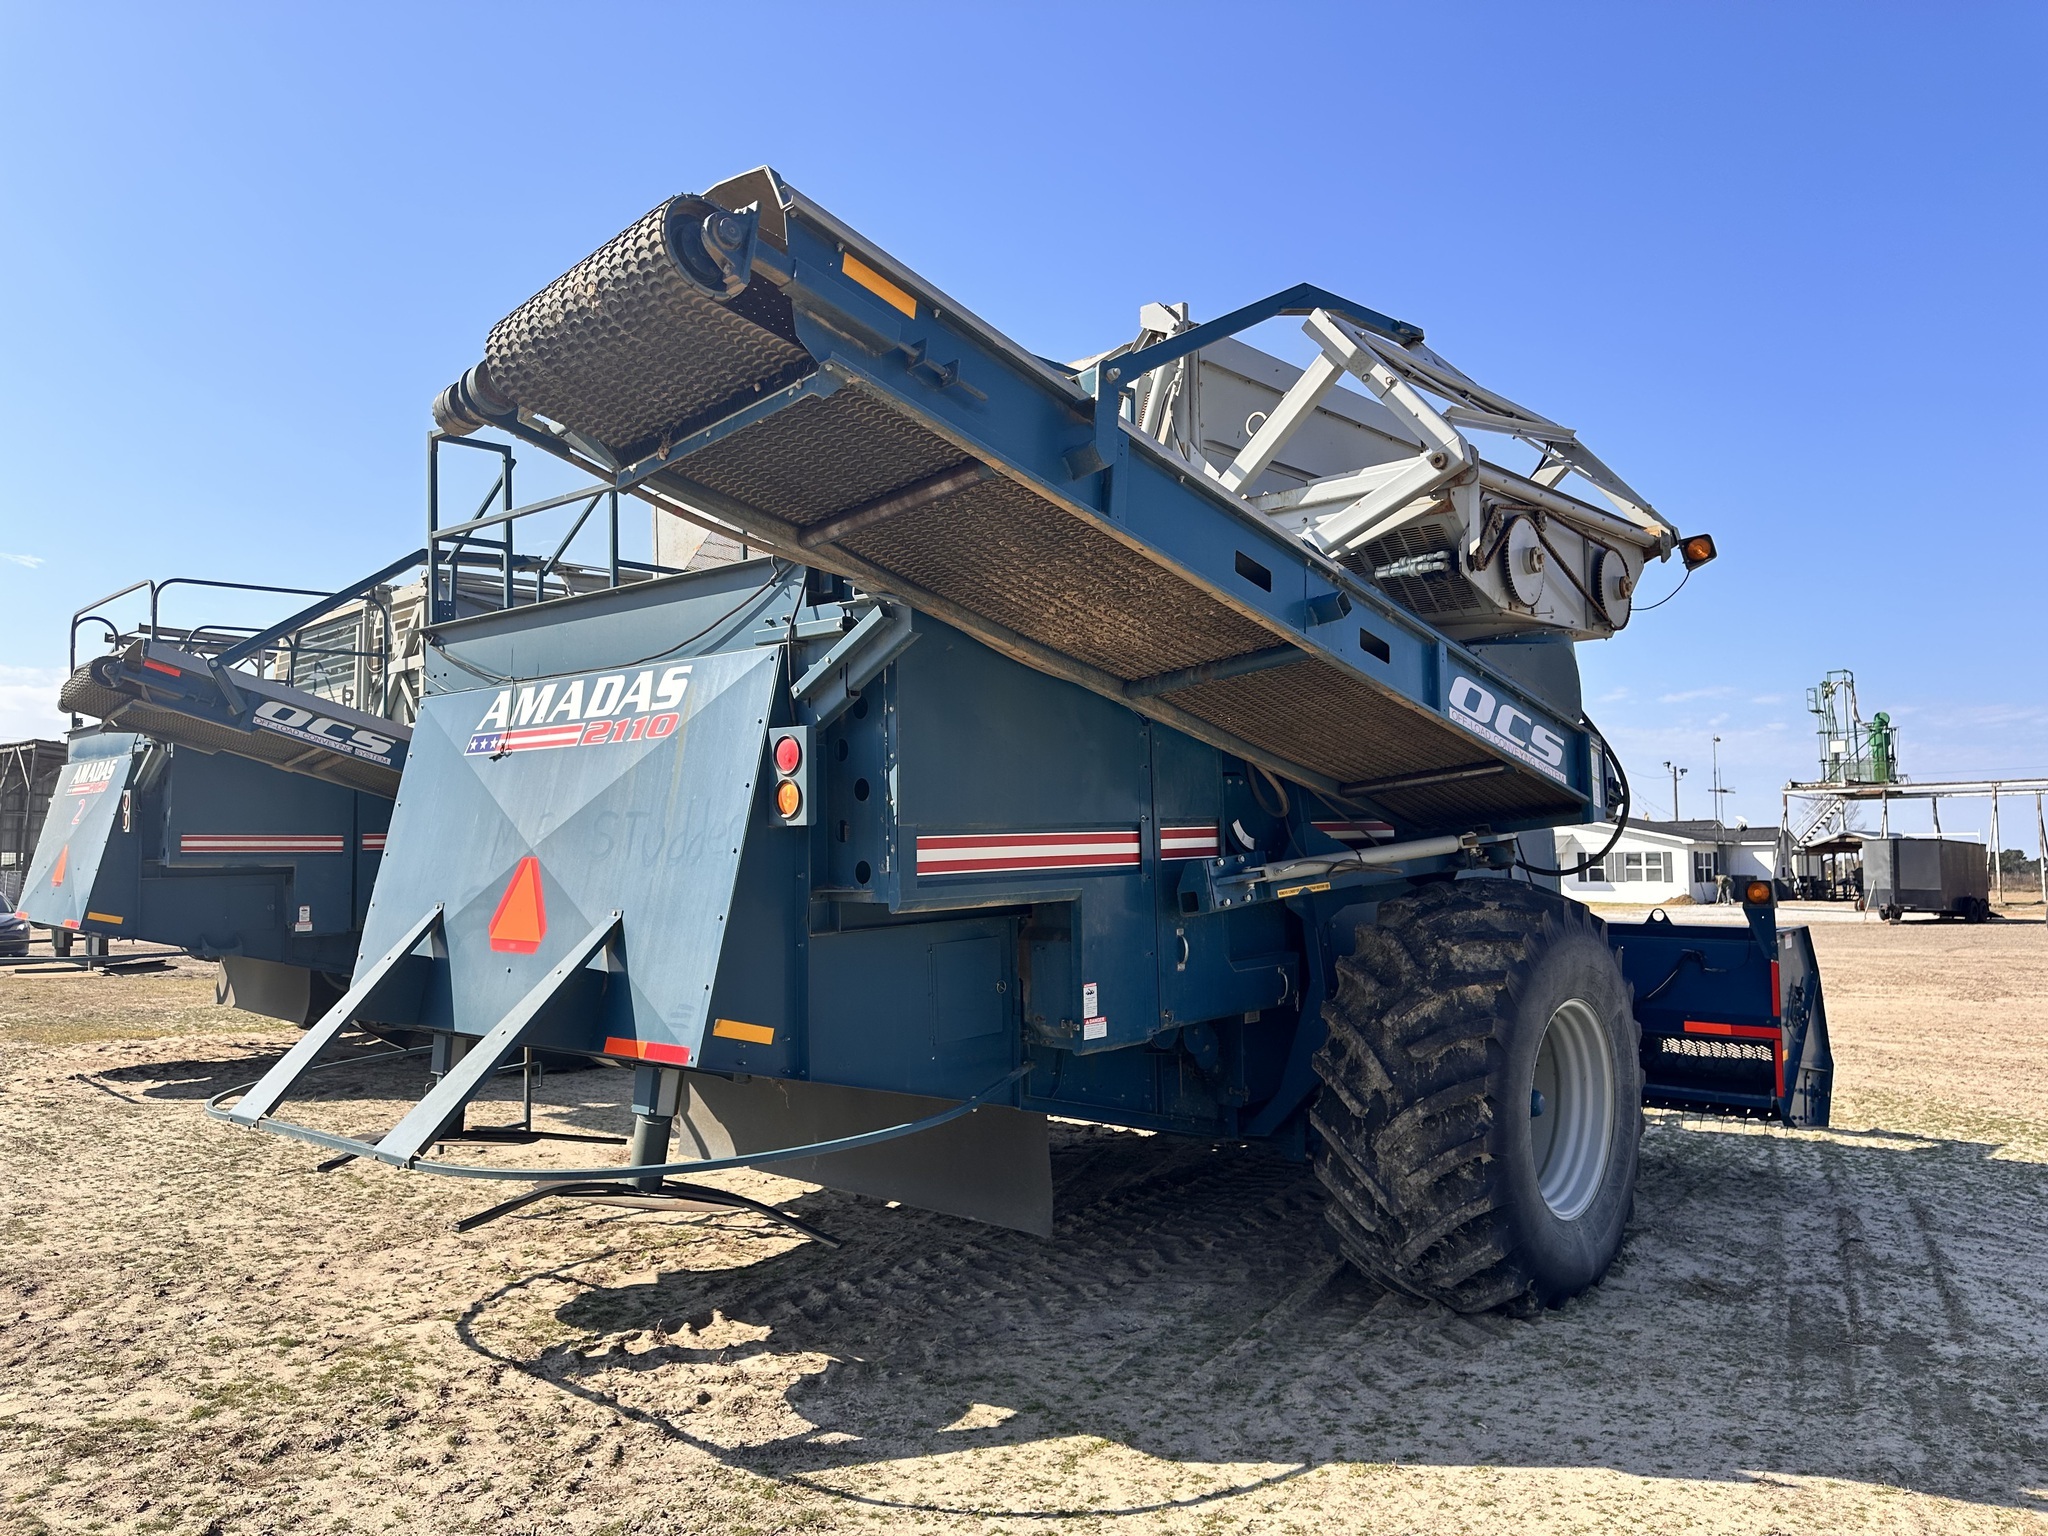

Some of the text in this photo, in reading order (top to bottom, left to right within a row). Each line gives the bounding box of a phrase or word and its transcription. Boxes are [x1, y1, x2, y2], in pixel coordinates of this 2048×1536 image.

[474, 665, 694, 731] AMADAS
[1448, 676, 1565, 767] OCS
[254, 717, 390, 765] OFF-LOAD CONVEYING SYSTEM
[255, 701, 397, 754] OCS
[580, 712, 681, 746] 2110
[1450, 709, 1492, 740] OFF-LOAD
[1493, 734, 1536, 766] CONVEYING
[1536, 763, 1566, 785] SYSTEM
[70, 760, 118, 785] AMADAS
[71, 799, 86, 825] 2
